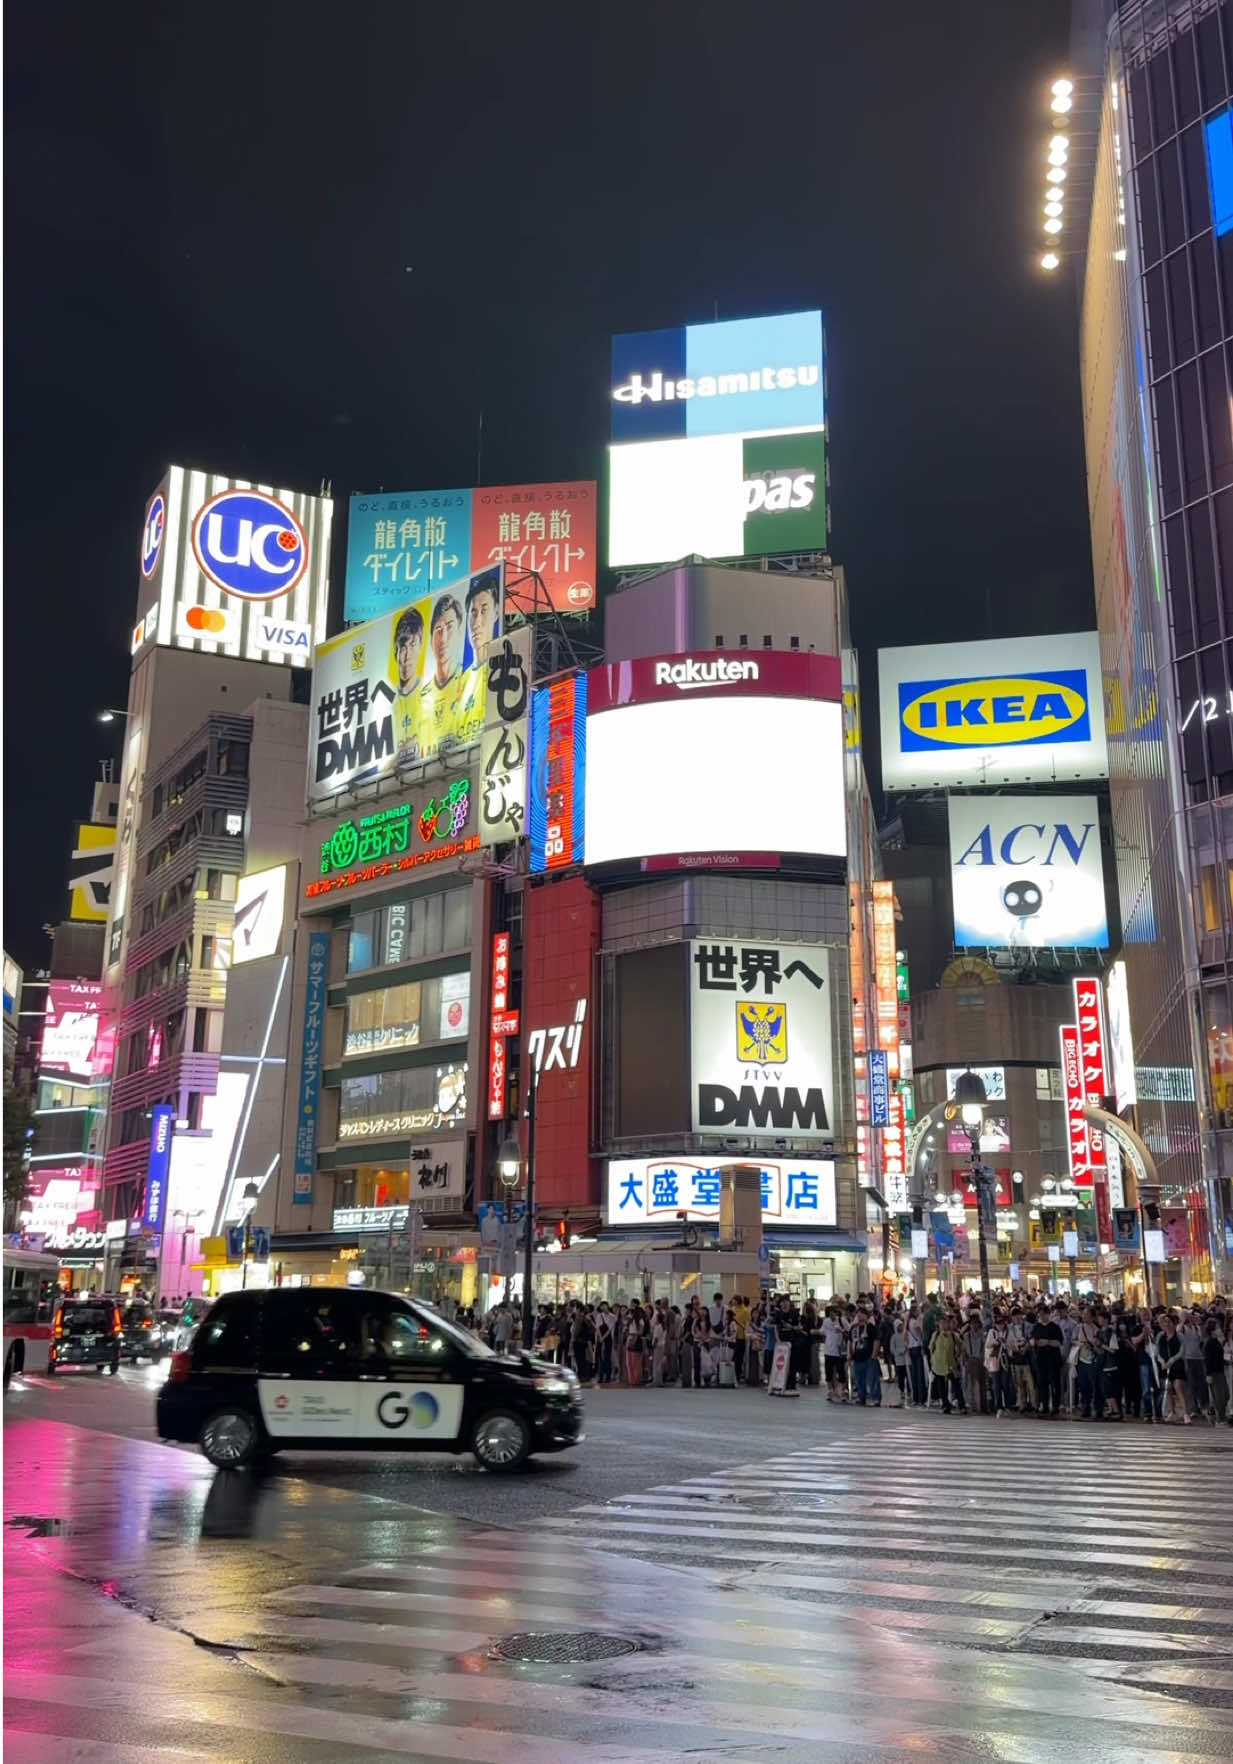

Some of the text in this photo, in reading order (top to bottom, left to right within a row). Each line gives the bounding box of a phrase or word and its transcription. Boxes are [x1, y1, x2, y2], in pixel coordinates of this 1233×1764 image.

[613, 364, 819, 404] Hisamitsu
[375, 515, 448, 549] 龍角散
[498, 509, 572, 543] 龍角散
[362, 550, 459, 583] ダイレクト
[262, 625, 308, 647] VISA
[655, 658, 759, 688] Rakuten
[317, 678, 396, 740] 世界へ
[919, 693, 1072, 728] IKEA
[315, 715, 394, 783] DMM
[483, 638, 529, 834] もんじゃ
[358, 817, 412, 863] 西村
[678, 854, 740, 867] Rakuten Vision
[955, 823, 1096, 866] ACN
[391, 905, 406, 926] BIC
[694, 945, 825, 995] 世界へ
[528, 998, 587, 1073] クスリ
[1077, 991, 1102, 1082] カラオケ
[698, 1084, 830, 1130] DMM
[156, 1114, 169, 1153] MIZUHO
[1068, 1098, 1089, 1176] カラオケ
